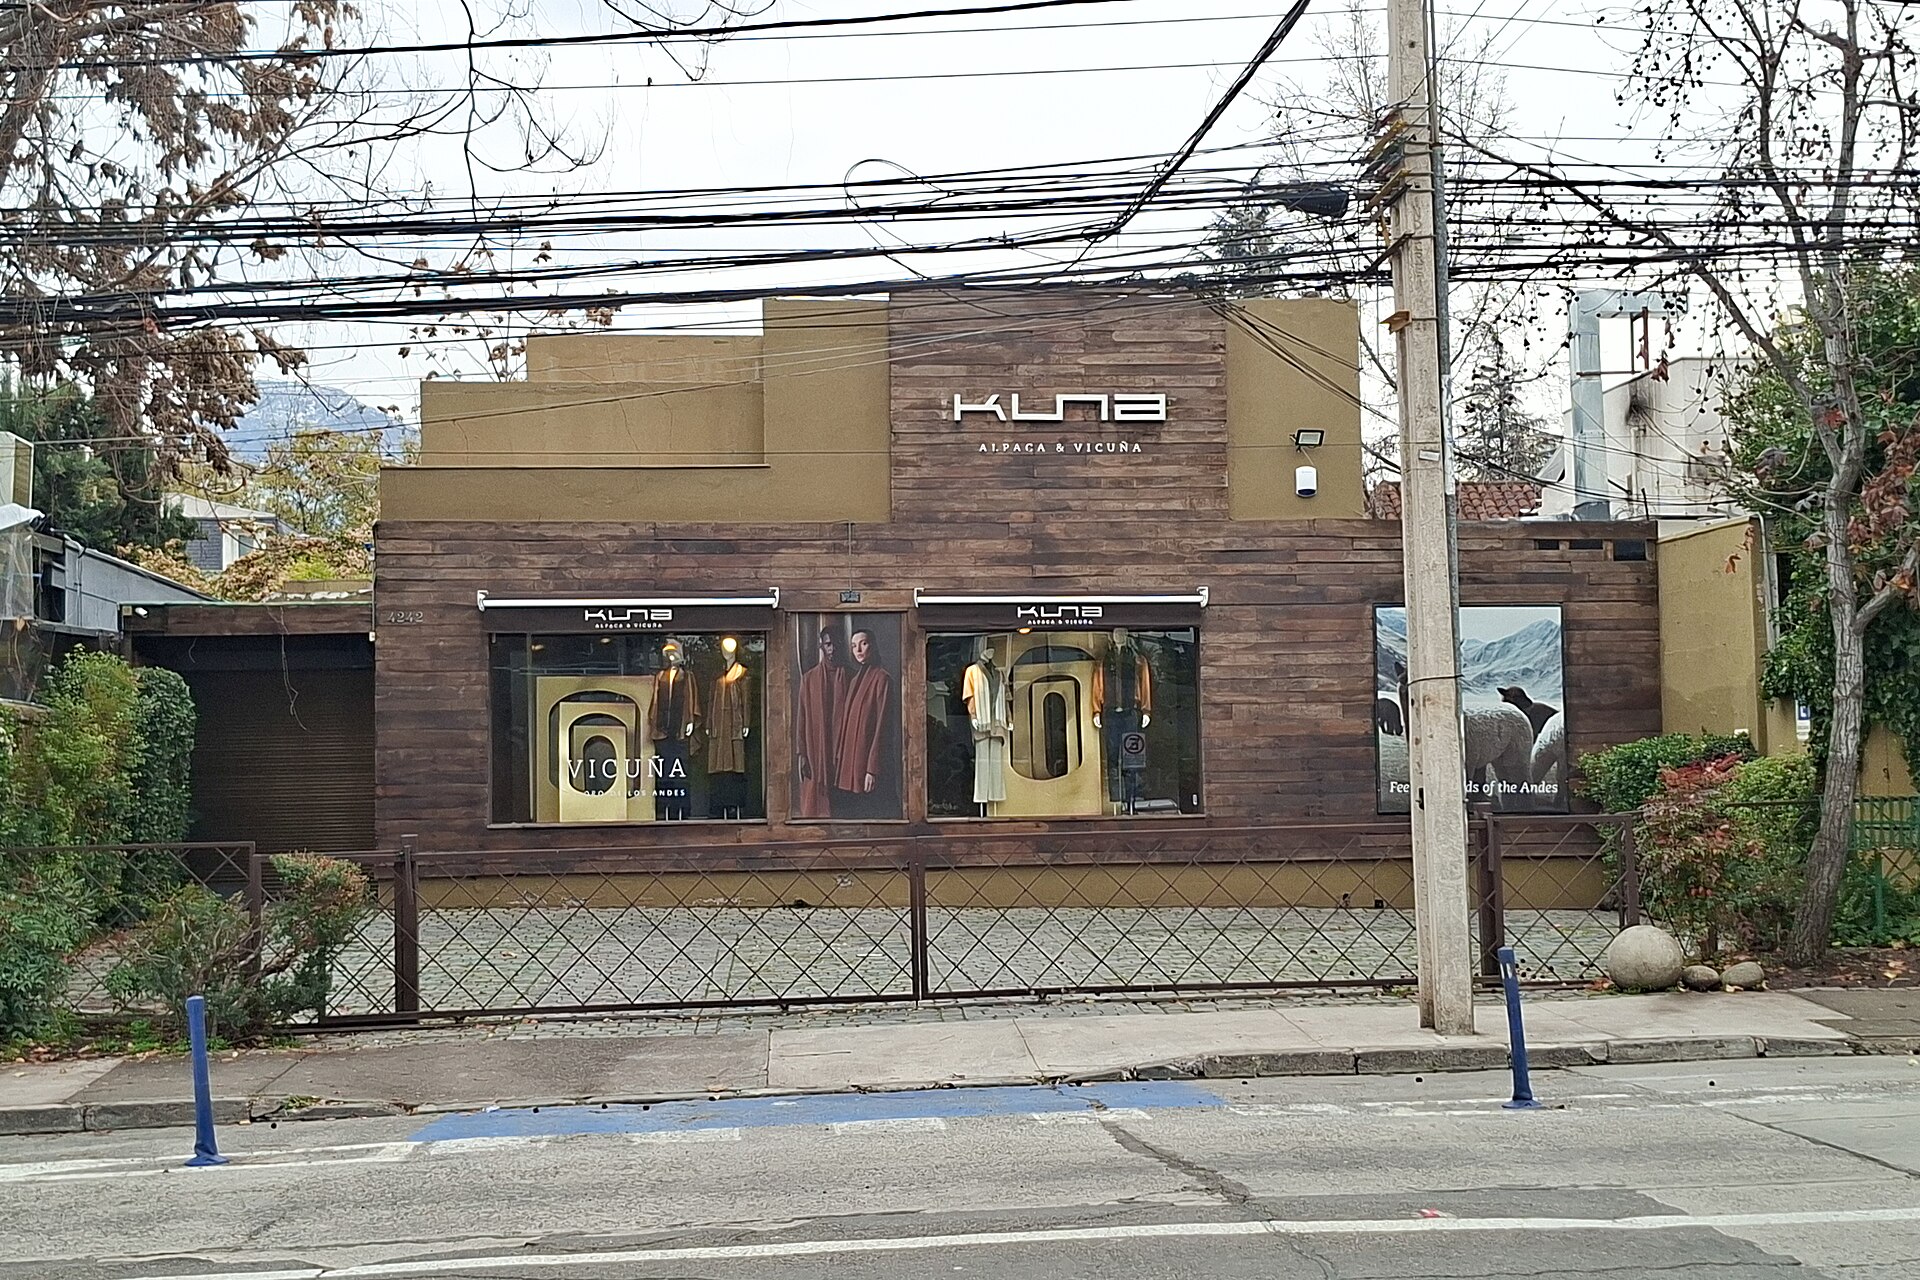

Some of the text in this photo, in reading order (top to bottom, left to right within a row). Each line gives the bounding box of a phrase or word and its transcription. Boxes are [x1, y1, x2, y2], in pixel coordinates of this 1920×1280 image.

[978, 440, 1142, 453] ALPACA & VICUÑA
[387, 611, 424, 623] 4242
[567, 755, 687, 779] VICUÑA
[652, 789, 686, 797] ANDES
[1389, 781, 1411, 793] Fee
[1483, 780, 1497, 797] of
[1498, 780, 1518, 793] the
[1520, 780, 1559, 793] Andes
